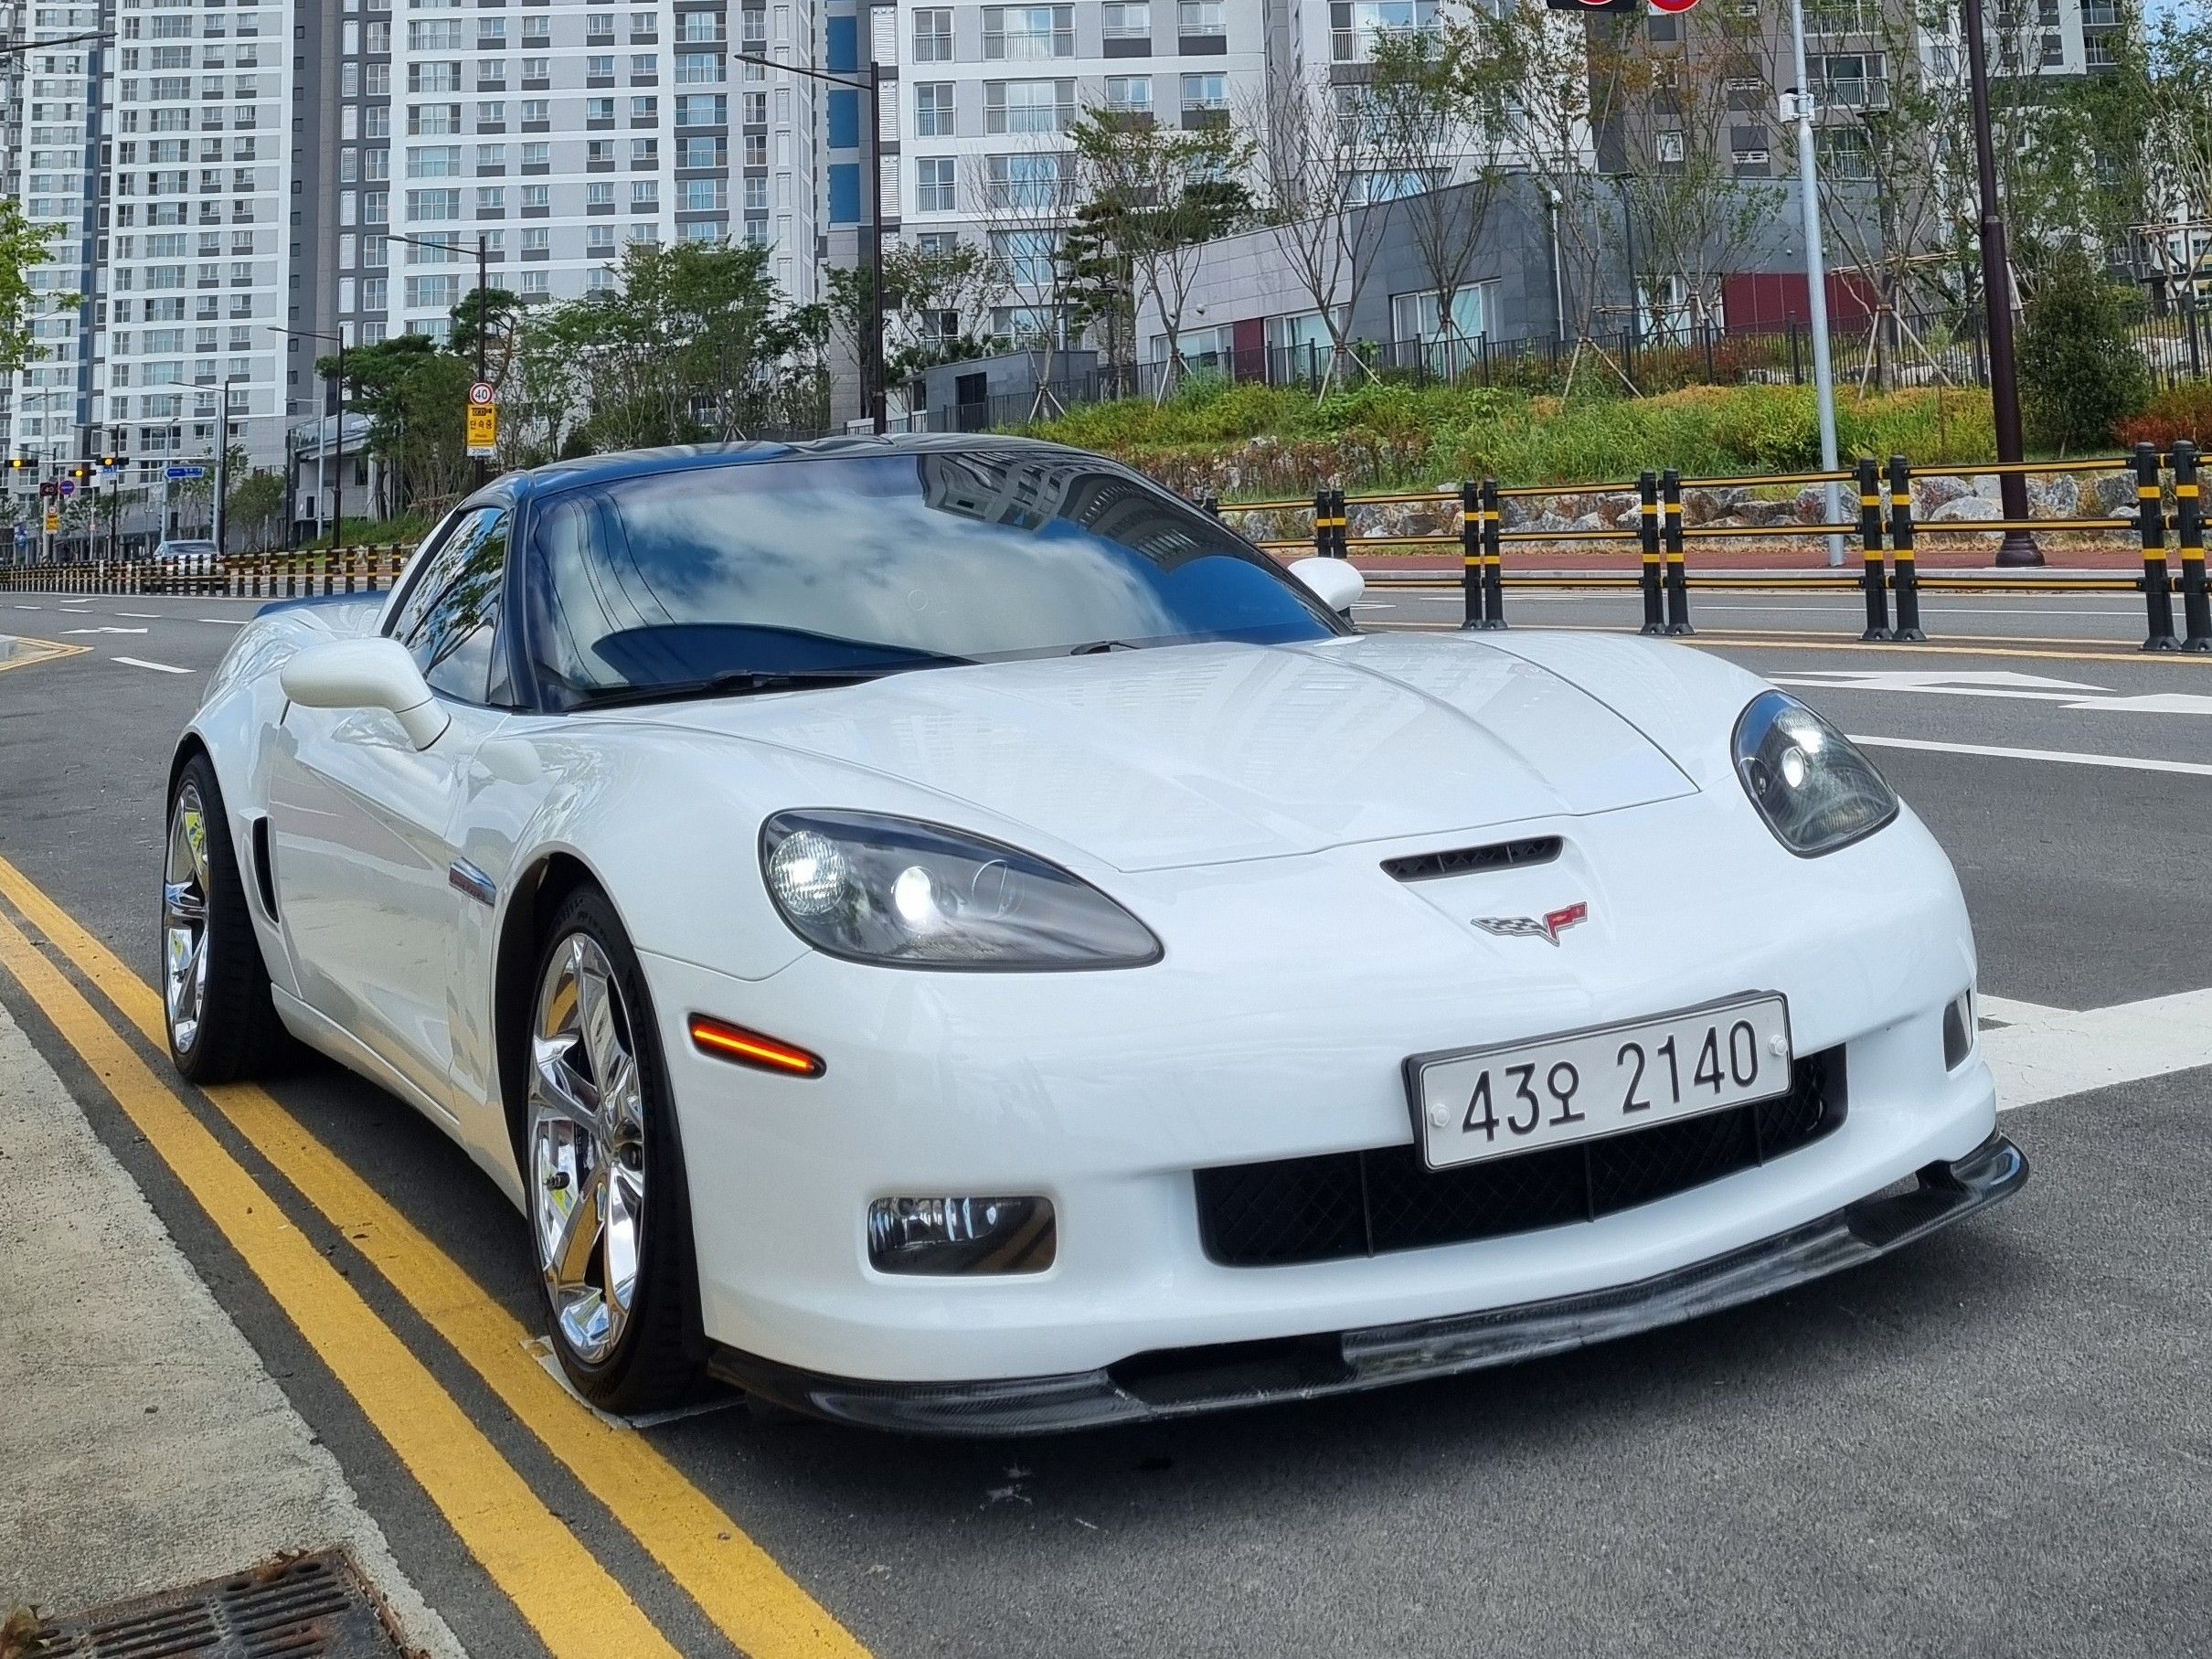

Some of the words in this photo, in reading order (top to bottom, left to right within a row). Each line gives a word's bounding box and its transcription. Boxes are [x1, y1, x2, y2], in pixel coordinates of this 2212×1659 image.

[475, 389, 487, 399] 40
[1462, 1061, 1585, 1142] 43오
[1617, 1019, 1759, 1113] 2140
